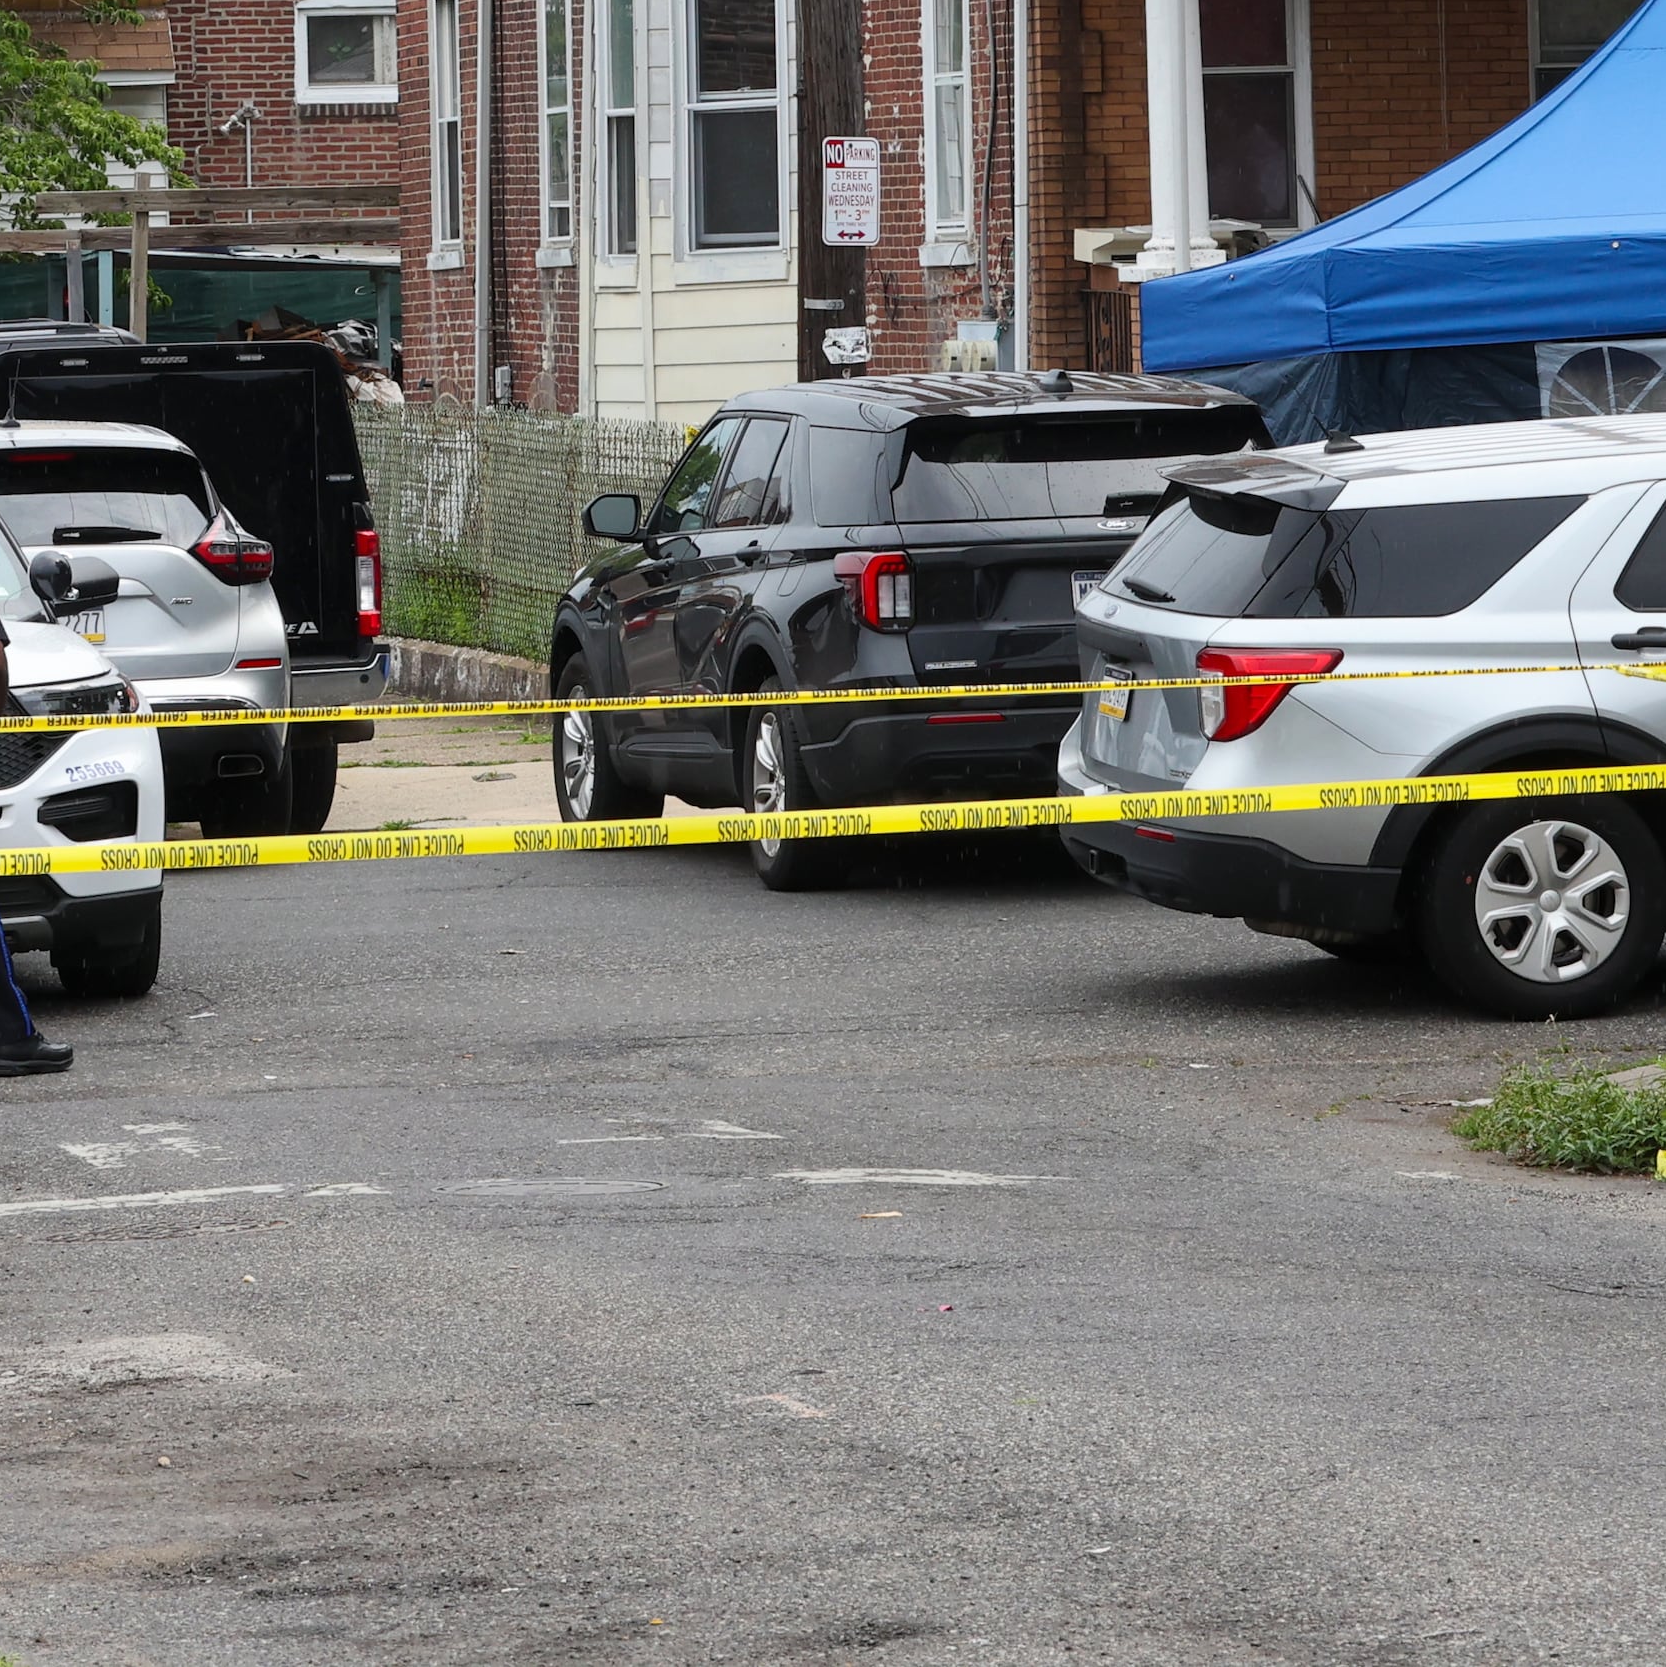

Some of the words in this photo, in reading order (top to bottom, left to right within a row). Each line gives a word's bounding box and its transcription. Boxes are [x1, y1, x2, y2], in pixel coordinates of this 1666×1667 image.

[826, 143, 844, 164] NO
[845, 148, 875, 161] PARKING
[835, 171, 869, 180] STREET
[831, 183, 873, 192] CLEANING
[828, 195, 875, 207] WEDNESDAY
[46, 717, 85, 727] ENTER
[89, 716, 112, 725] NOT
[115, 715, 132, 724] DO
[135, 713, 188, 723] CAUTION
[65, 760, 125, 783] 255669
[1120, 798, 1157, 819] CROSS
[1162, 797, 1183, 817] NOT
[1186, 796, 1201, 815] DO
[1204, 795, 1229, 814] LINE
[1232, 793, 1271, 812] POLICE
[920, 808, 958, 830] CROSS
[962, 808, 983, 828] NOT
[986, 807, 1002, 826] DO
[1005, 805, 1029, 825] LINE
[1032, 803, 1072, 824] POLICE
[628, 824, 668, 845] POLICE
[717, 819, 756, 841] CROSS
[760, 818, 781, 838] NOT
[784, 817, 800, 837] DO
[803, 816, 828, 836] LINE
[831, 814, 871, 835] POLICE
[395, 835, 420, 857] LINE
[424, 834, 464, 855] POLICE
[514, 829, 552, 851] CROSS
[556, 828, 578, 849] NOT
[581, 827, 597, 848] DO
[600, 826, 625, 846] LINE
[144, 847, 166, 868] NOT
[169, 846, 185, 867] DO
[188, 845, 214, 866] LINE
[217, 843, 258, 865] POLICE
[307, 838, 346, 861] CROSS
[350, 838, 372, 859] NOT
[376, 837, 392, 858] DO
[10, 853, 51, 874] POLICE
[101, 848, 140, 870] CROSS
